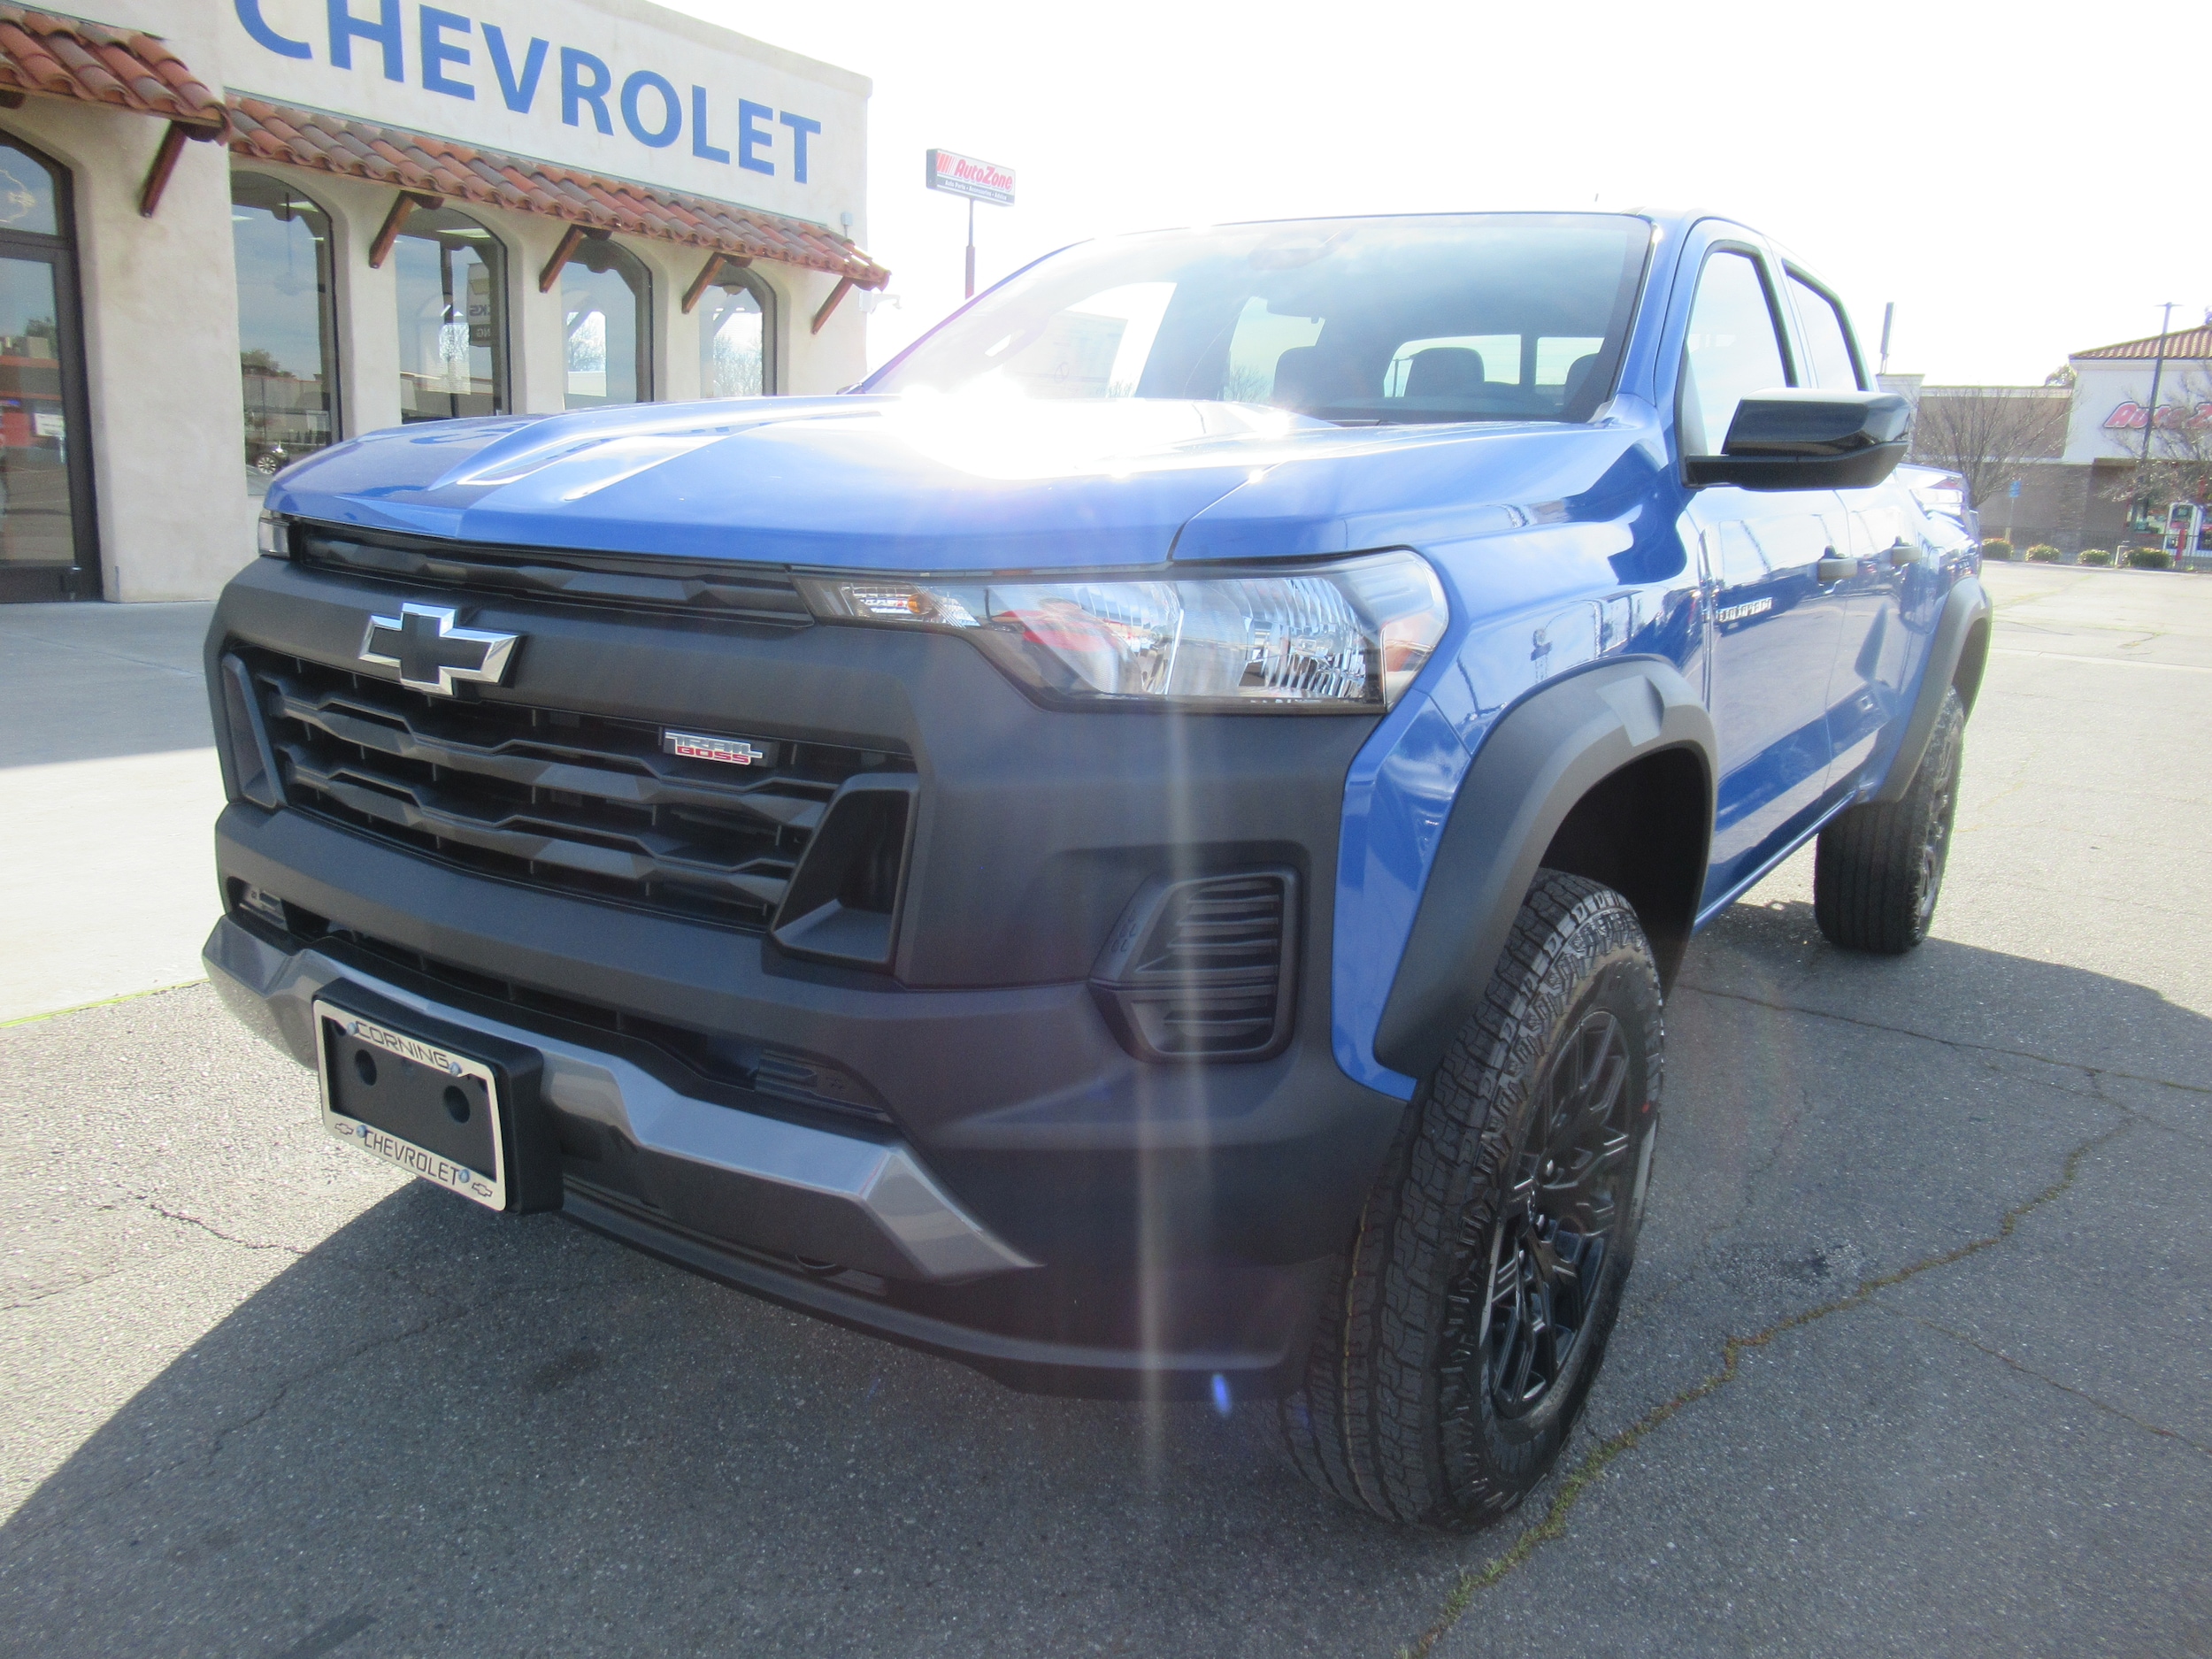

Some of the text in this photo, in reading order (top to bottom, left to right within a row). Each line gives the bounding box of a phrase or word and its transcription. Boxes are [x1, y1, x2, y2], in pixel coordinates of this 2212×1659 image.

[234, 0, 822, 185] CHEVROLET
[954, 158, 1013, 190] AutoZone
[677, 746, 750, 764] BOSS
[355, 1020, 450, 1070] CORNING
[364, 1129, 460, 1186] CHEVROLET
